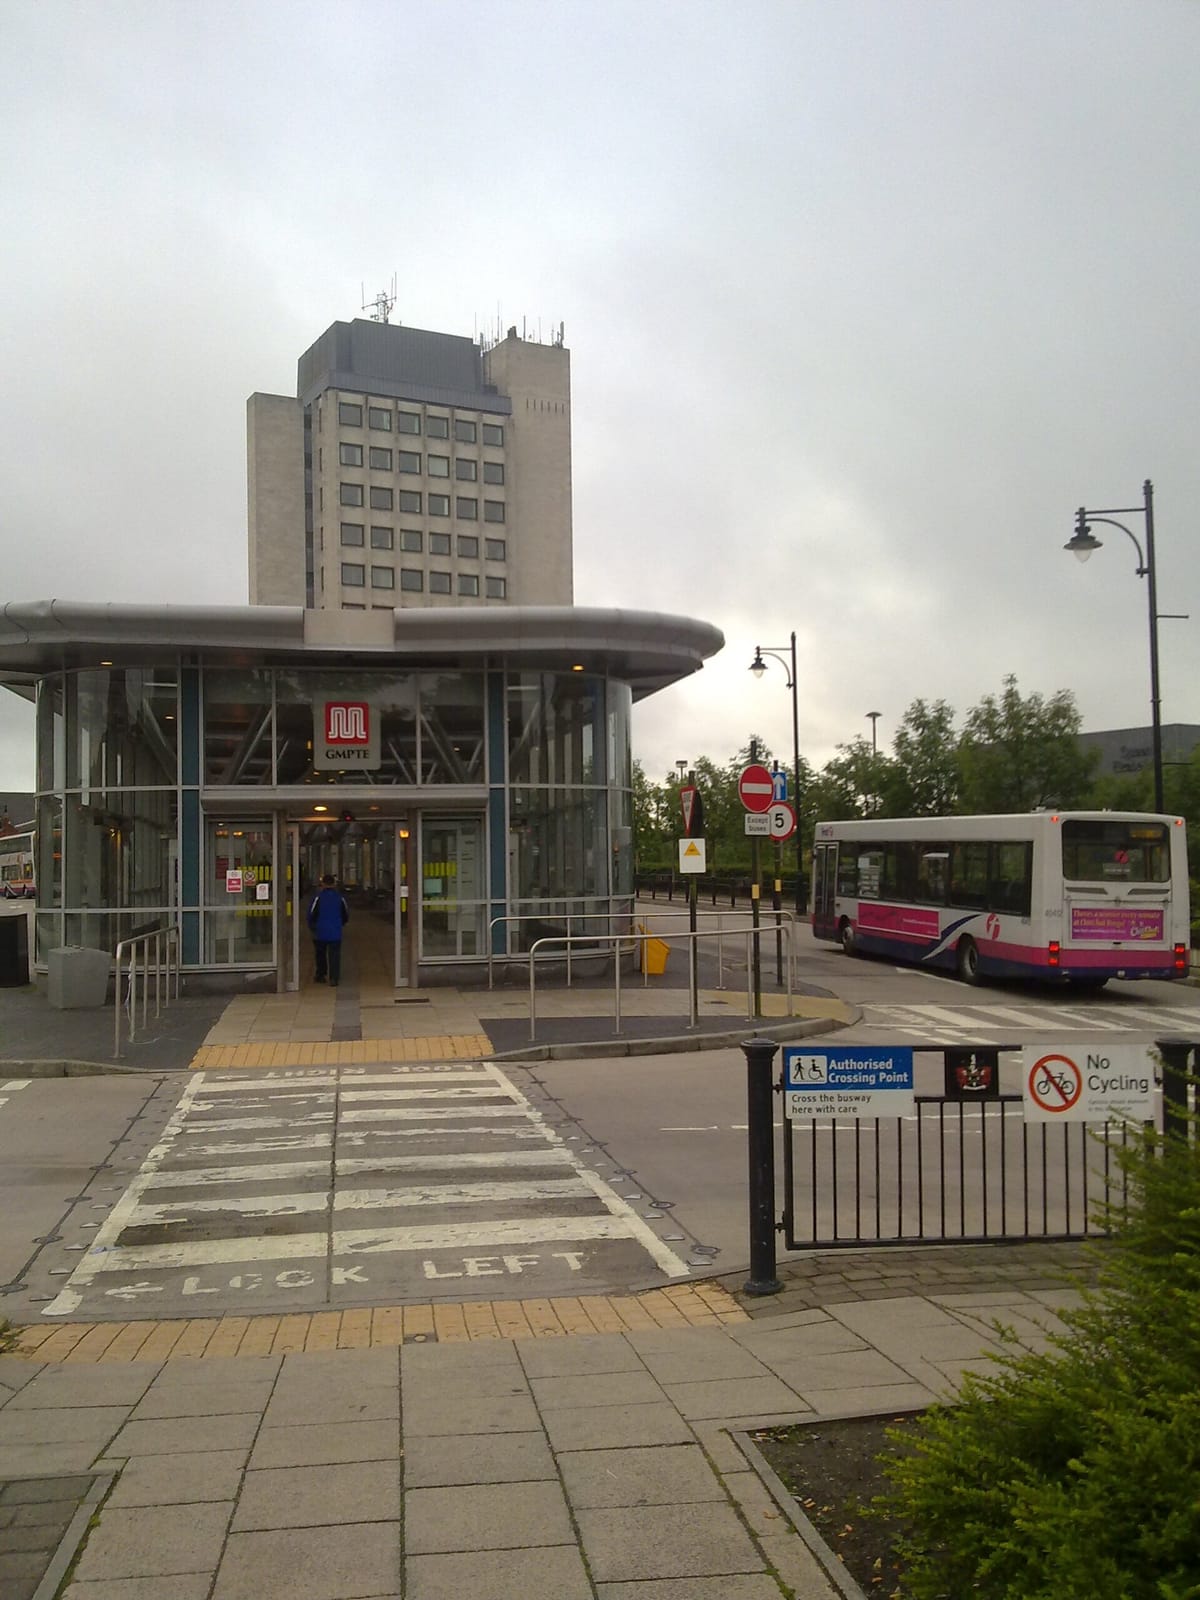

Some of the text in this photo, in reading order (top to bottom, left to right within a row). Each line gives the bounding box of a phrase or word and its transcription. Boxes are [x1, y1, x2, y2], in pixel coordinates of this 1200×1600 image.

[325, 749, 369, 760] GMPTE
[747, 816, 768, 824] Except
[775, 813, 784, 828] 5
[391, 1062, 474, 1074] LOOK
[829, 1059, 893, 1070] Authorised
[1087, 1055, 1110, 1069] No
[828, 1072, 908, 1085] Crossing Point
[1088, 1075, 1149, 1093] Cycling
[791, 1094, 871, 1103] Cross the busway
[791, 1105, 812, 1113] here
[815, 1105, 835, 1113] with
[182, 1252, 584, 1296] LOOK LEFT
